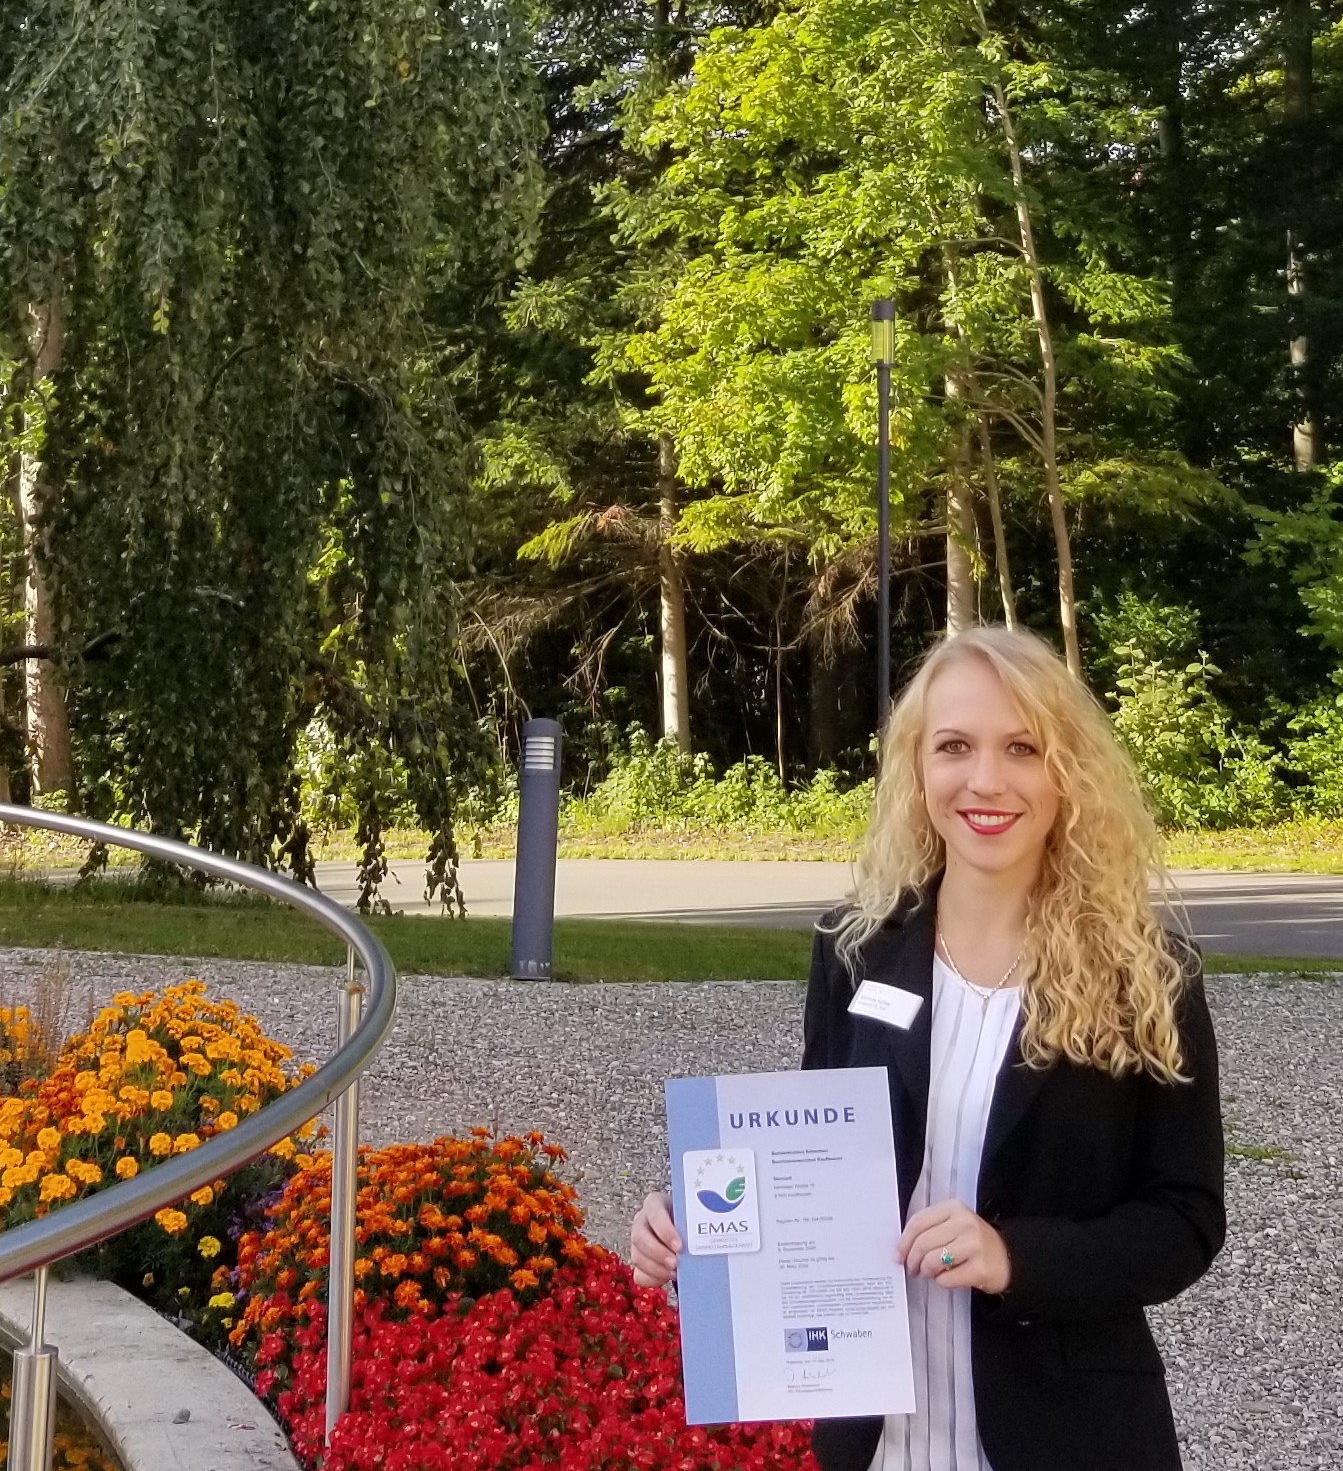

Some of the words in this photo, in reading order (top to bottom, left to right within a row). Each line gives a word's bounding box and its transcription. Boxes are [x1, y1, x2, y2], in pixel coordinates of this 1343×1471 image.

[729, 1107, 855, 1129] URKUNDE
[697, 1220, 749, 1235] EMAS
[808, 1330, 827, 1341] IHK
[830, 1329, 873, 1339] Schwaben
